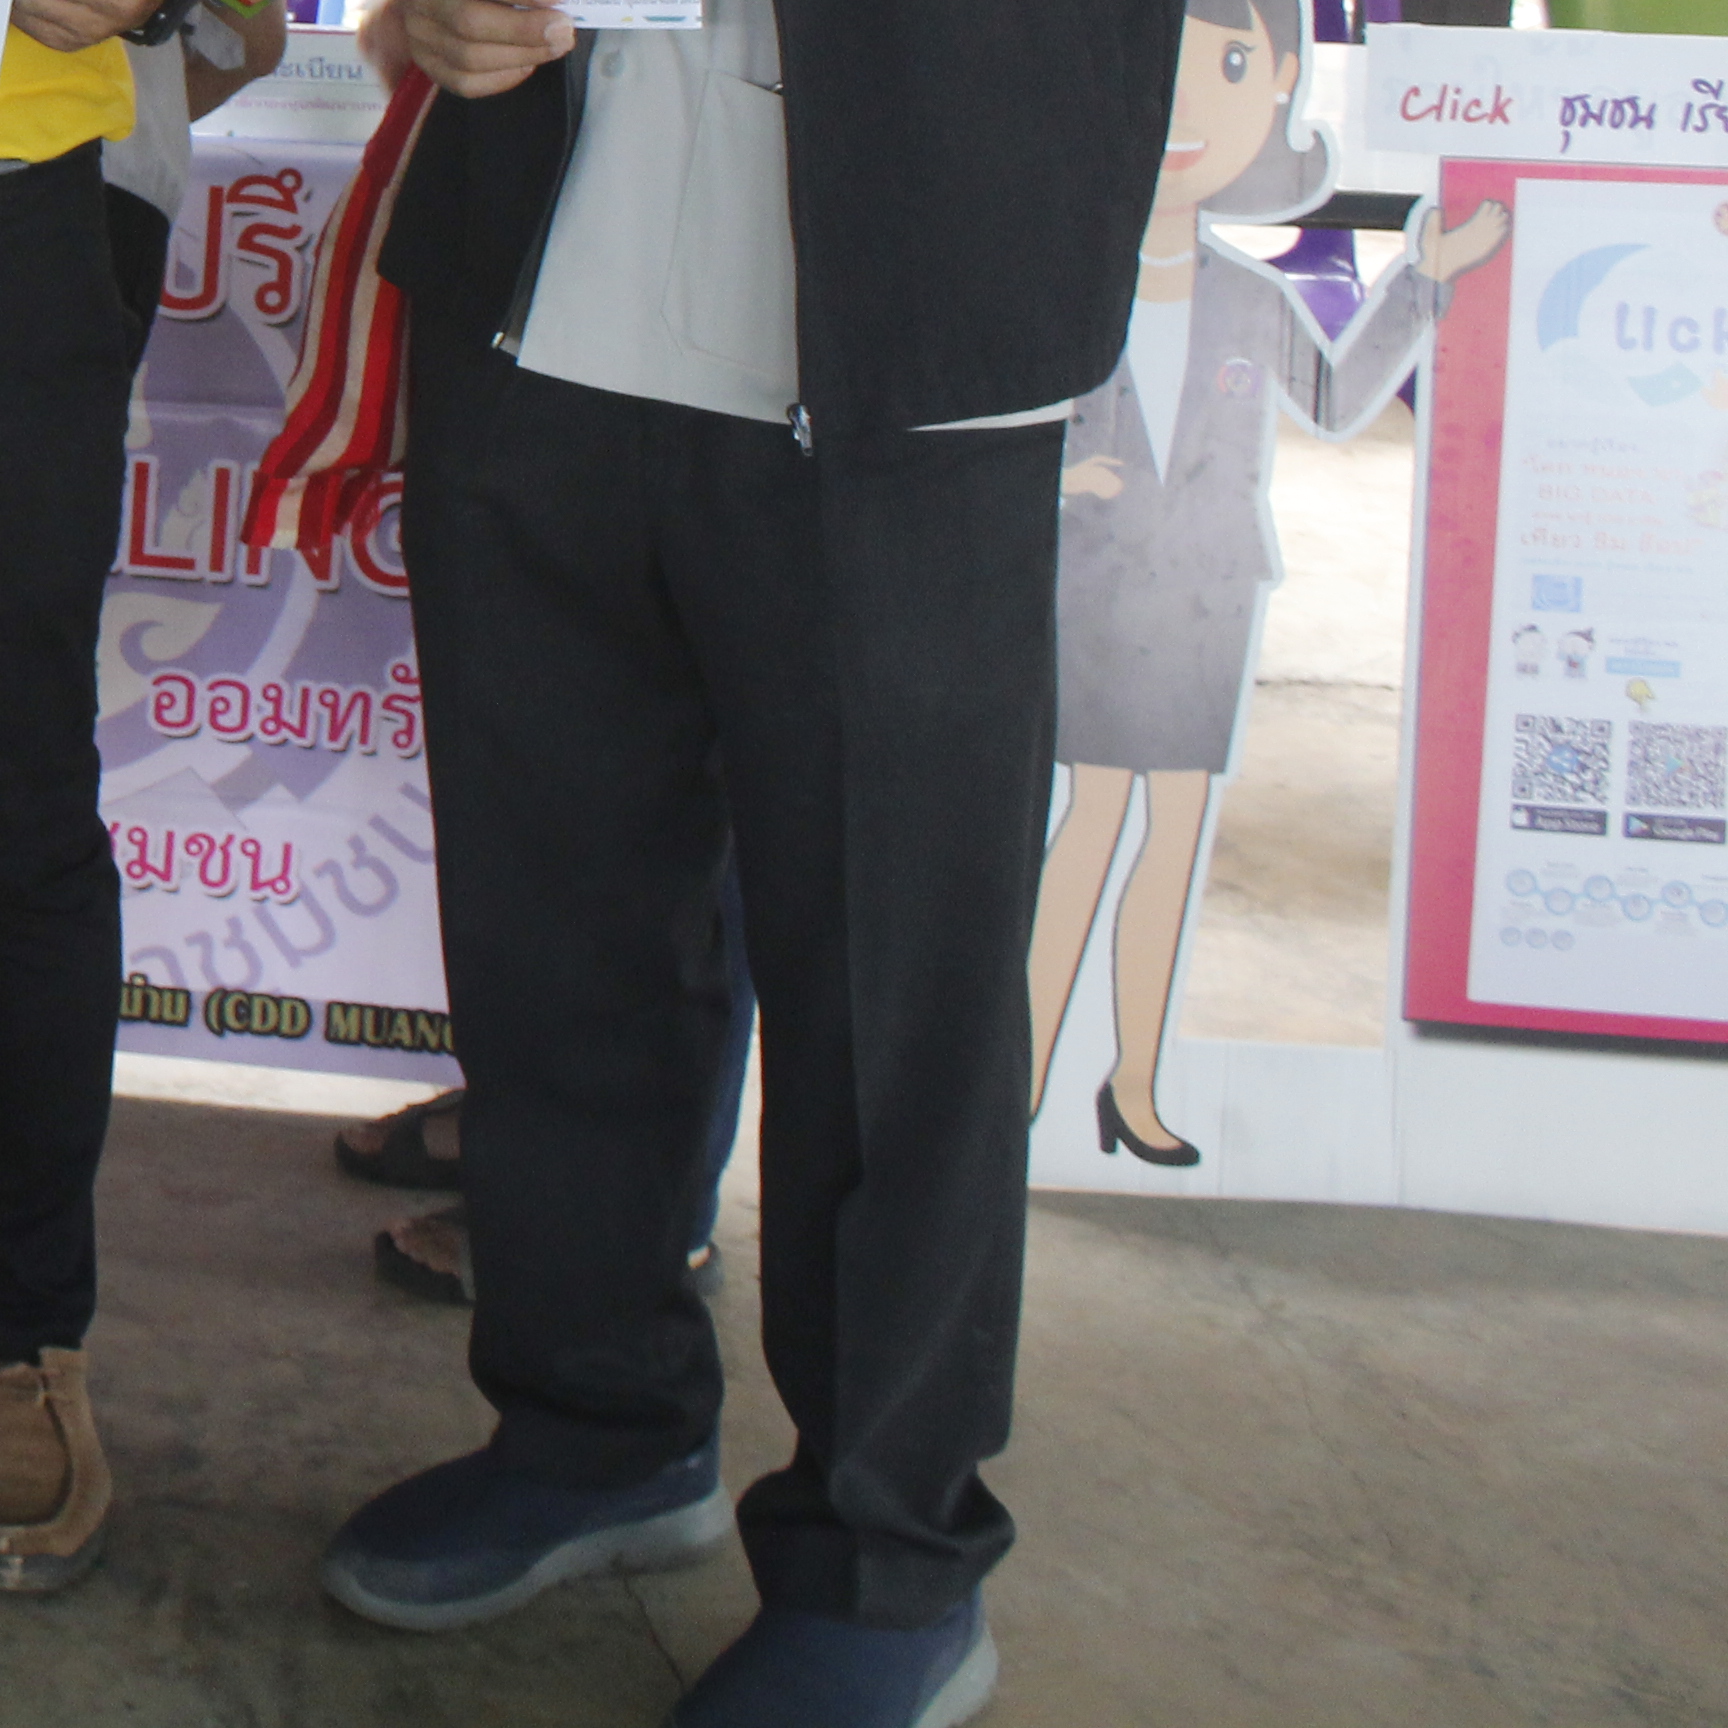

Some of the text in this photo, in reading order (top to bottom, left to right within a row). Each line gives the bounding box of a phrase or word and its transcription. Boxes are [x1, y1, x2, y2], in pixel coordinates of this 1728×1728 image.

[1400, 83, 1513, 125] Click
[1558, 92, 1657, 154] ชุมชน
[108, 821, 292, 896] มชน
[204, 989, 311, 1038] (CDD
